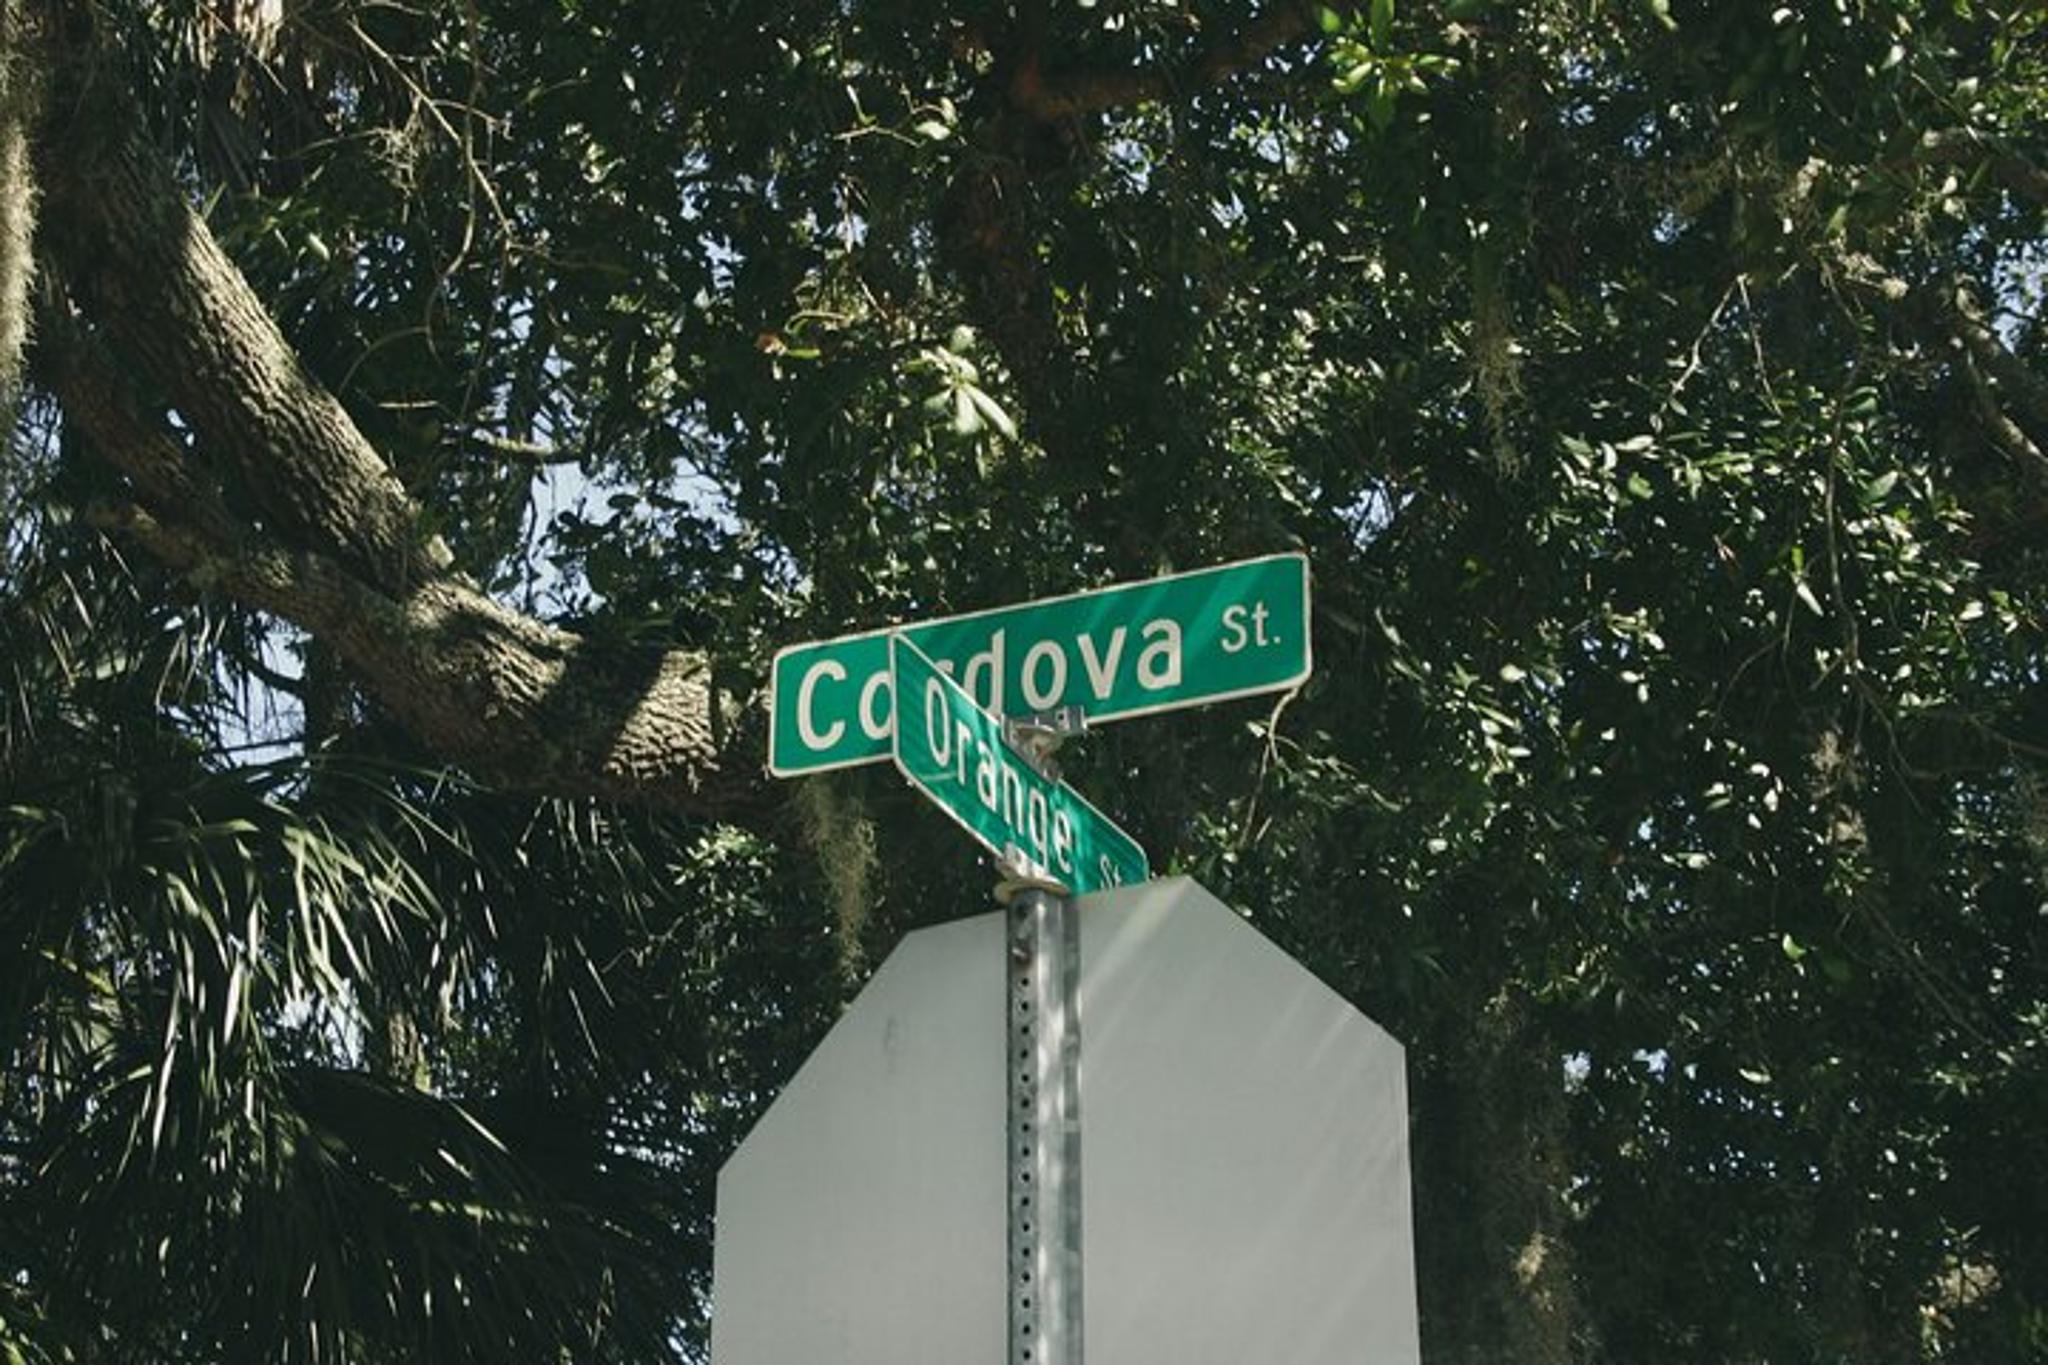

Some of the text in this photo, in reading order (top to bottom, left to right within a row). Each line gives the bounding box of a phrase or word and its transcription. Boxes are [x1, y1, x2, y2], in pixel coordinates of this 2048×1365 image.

[797, 601, 1281, 751] Codova St.
[925, 677, 1072, 874] Orange
